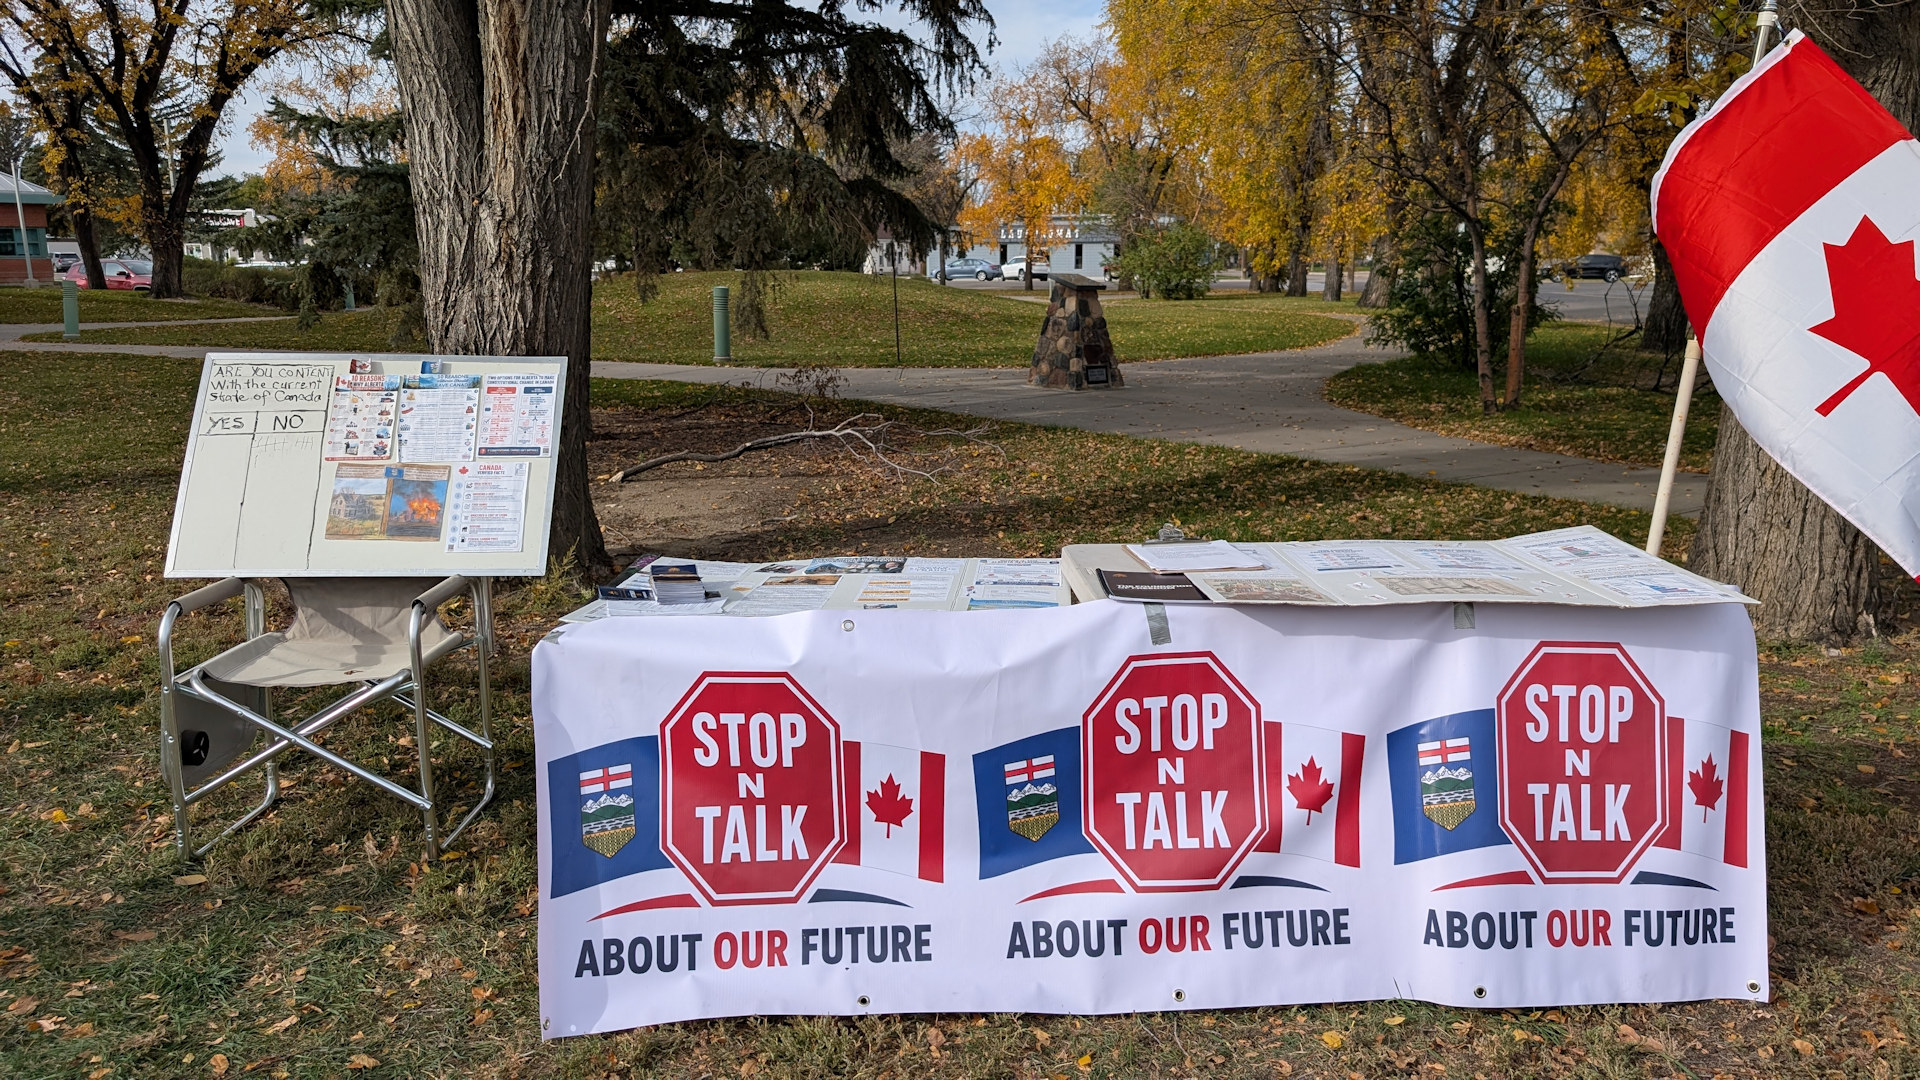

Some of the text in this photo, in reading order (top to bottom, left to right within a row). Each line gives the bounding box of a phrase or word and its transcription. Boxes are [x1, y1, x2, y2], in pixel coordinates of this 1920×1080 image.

[210, 379, 322, 390] With the current
[214, 366, 331, 378] ARE YOU CONTENT
[254, 390, 270, 406] of
[274, 390, 322, 402] Canada
[206, 417, 244, 434] YES
[273, 414, 303, 430] NO
[1114, 693, 1228, 754] STOP
[1525, 683, 1634, 744] STOP
[692, 712, 807, 768] STOP
[1158, 758, 1184, 784] N
[1564, 748, 1590, 776] N
[738, 772, 764, 798] N
[696, 804, 810, 864] TALK
[1116, 790, 1232, 850] TALK
[1528, 783, 1632, 842] TALK
[1006, 908, 1351, 959] ABOUT OUR FUTURE
[1423, 907, 1736, 950] ABOUT OUR FUTURE
[574, 924, 932, 978] ABOUT OUR FUTURE
